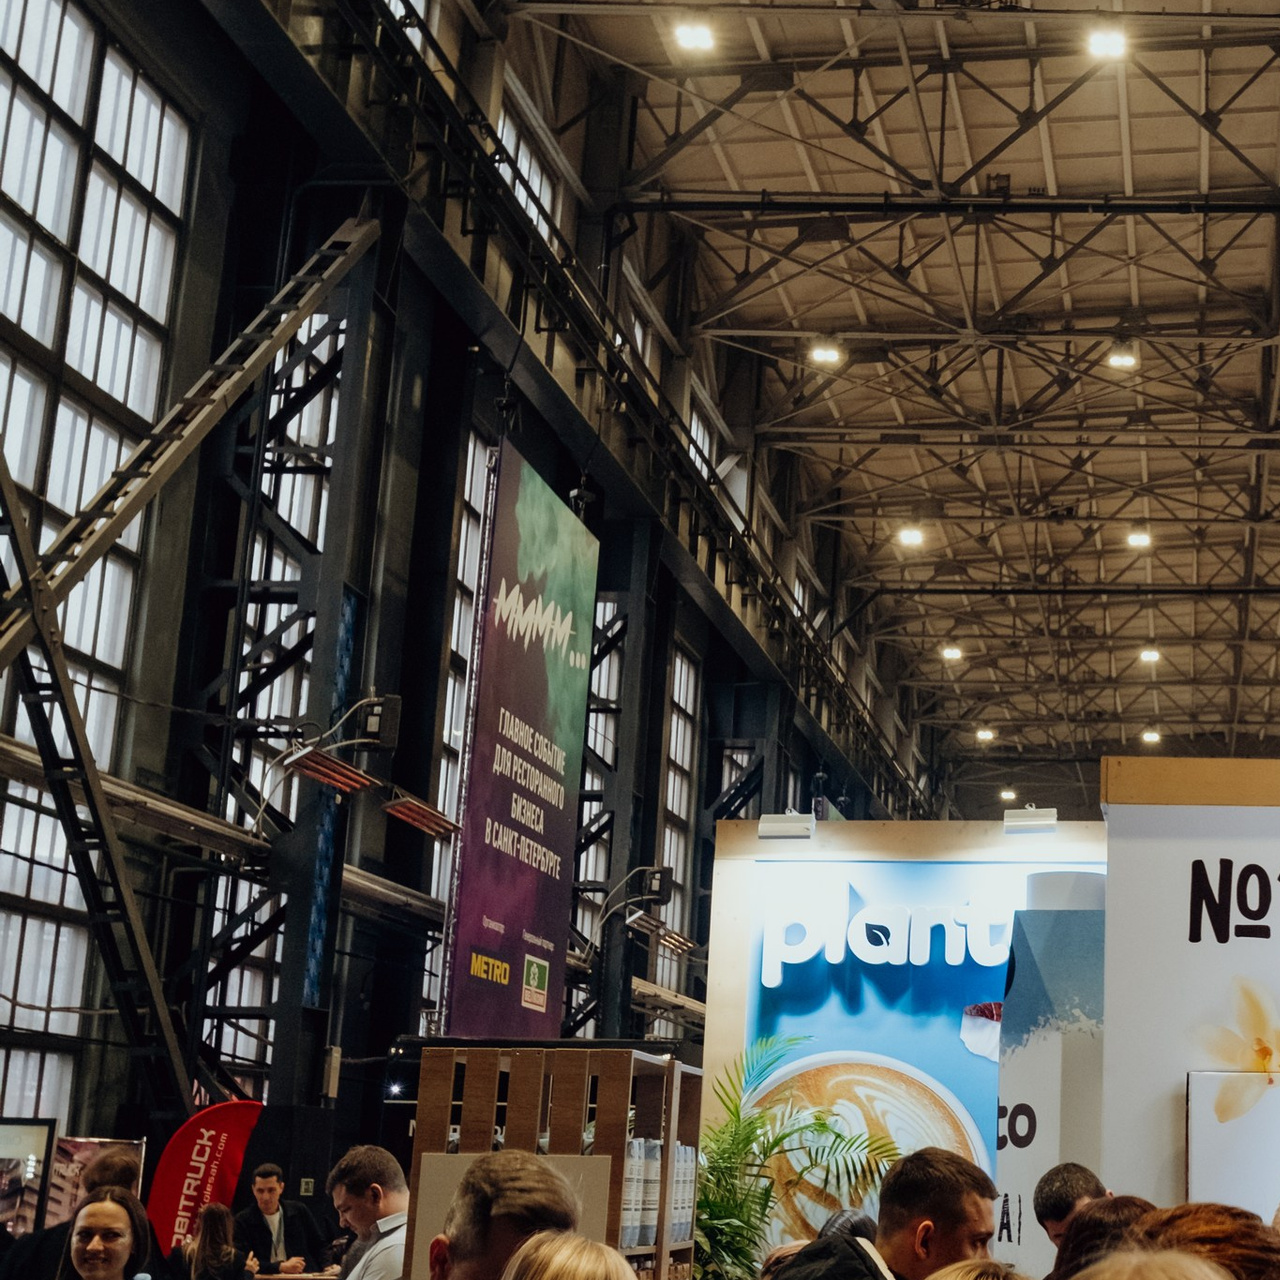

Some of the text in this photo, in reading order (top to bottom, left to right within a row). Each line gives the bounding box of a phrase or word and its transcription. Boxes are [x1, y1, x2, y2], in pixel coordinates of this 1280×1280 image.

[498, 706, 566, 776] ГЛАВНОЕ СОБЫТИЕ
[492, 743, 565, 811] ДЛЯ РЕСТОРАННОГО
[510, 792, 544, 835] БИЗНЕСА
[484, 817, 562, 880] В САНКТ-ПЕТЕРБУРГЕ
[761, 880, 1010, 988] plant
[470, 952, 510, 985] METRO
